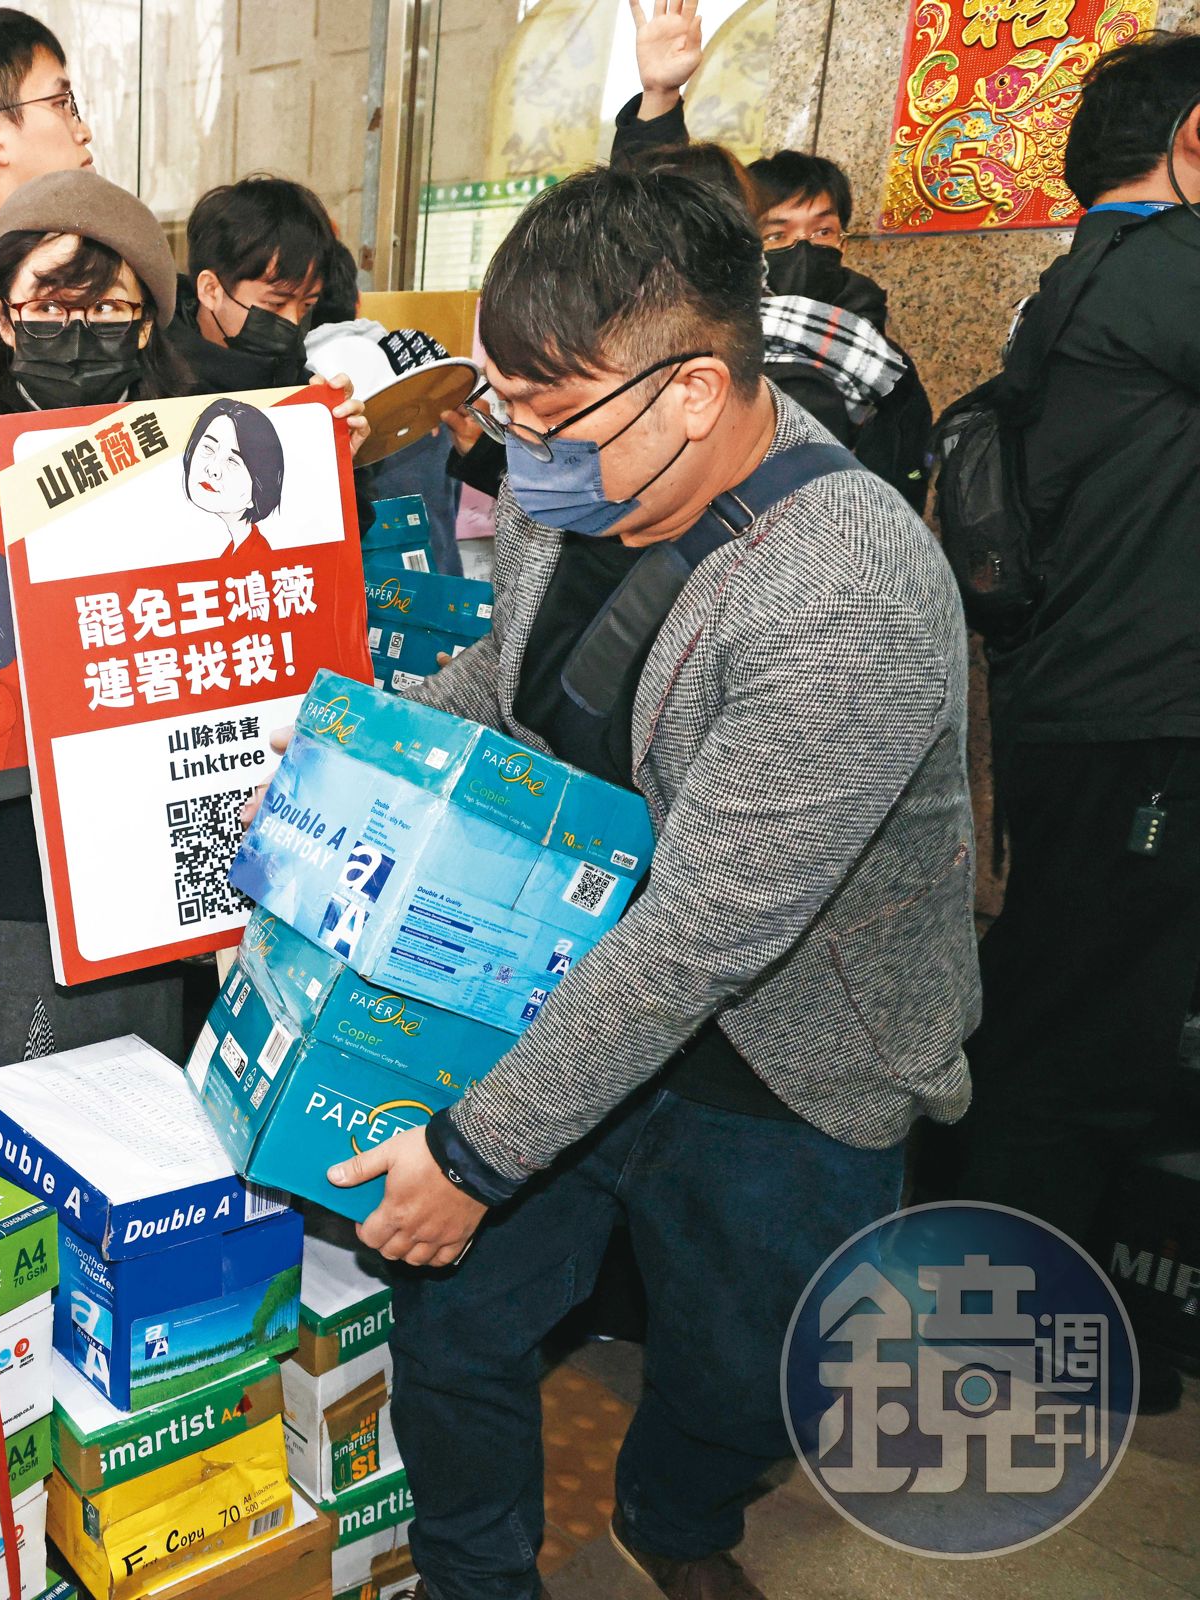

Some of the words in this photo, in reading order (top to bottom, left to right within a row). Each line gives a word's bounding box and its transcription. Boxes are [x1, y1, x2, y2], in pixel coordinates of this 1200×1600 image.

[36, 411, 170, 509] 山除薇害
[75, 564, 318, 650] 罷免王鴻薇
[365, 587, 393, 601] PAPER
[84, 631, 296, 711] 連署找我!
[306, 702, 337, 725] PAPER
[168, 716, 261, 754] 山除薇害
[170, 749, 266, 781] Linktree
[482, 750, 521, 777] PAPER
[499, 752, 545, 797] One
[469, 778, 512, 807] Copier
[272, 793, 326, 839] Double
[327, 826, 347, 850] A
[259, 816, 335, 871] EVERYDAY
[562, 831, 576, 848] 70
[417, 886, 438, 898] Double
[445, 897, 462, 907] Quality
[350, 991, 392, 1018] PAPER
[531, 989, 544, 1002] A4
[368, 995, 422, 1037] One
[338, 1020, 383, 1047] Copier
[332, 1033, 344, 1044] High
[359, 1043, 381, 1058] Premium
[381, 1053, 395, 1065] Copy
[394, 1058, 408, 1069] Paper
[436, 1069, 451, 1085] 70
[64, 1185, 82, 1219] A
[123, 1204, 206, 1245] Double
[213, 1195, 231, 1219] A
[14, 1237, 47, 1277] A4
[64, 1236, 109, 1274] Smoother
[13, 1276, 24, 1288] 70
[26, 1262, 48, 1283] GSM
[79, 1258, 115, 1293] Thicker
[76, 1326, 97, 1347] Double
[8, 1434, 38, 1472] A4
[333, 1429, 376, 1462] smartist
[18, 1456, 39, 1476] GSM
[243, 1494, 253, 1505] A4
[245, 1501, 260, 1515] 500
[166, 1527, 205, 1553] Copy
[218, 1504, 241, 1528] 70
